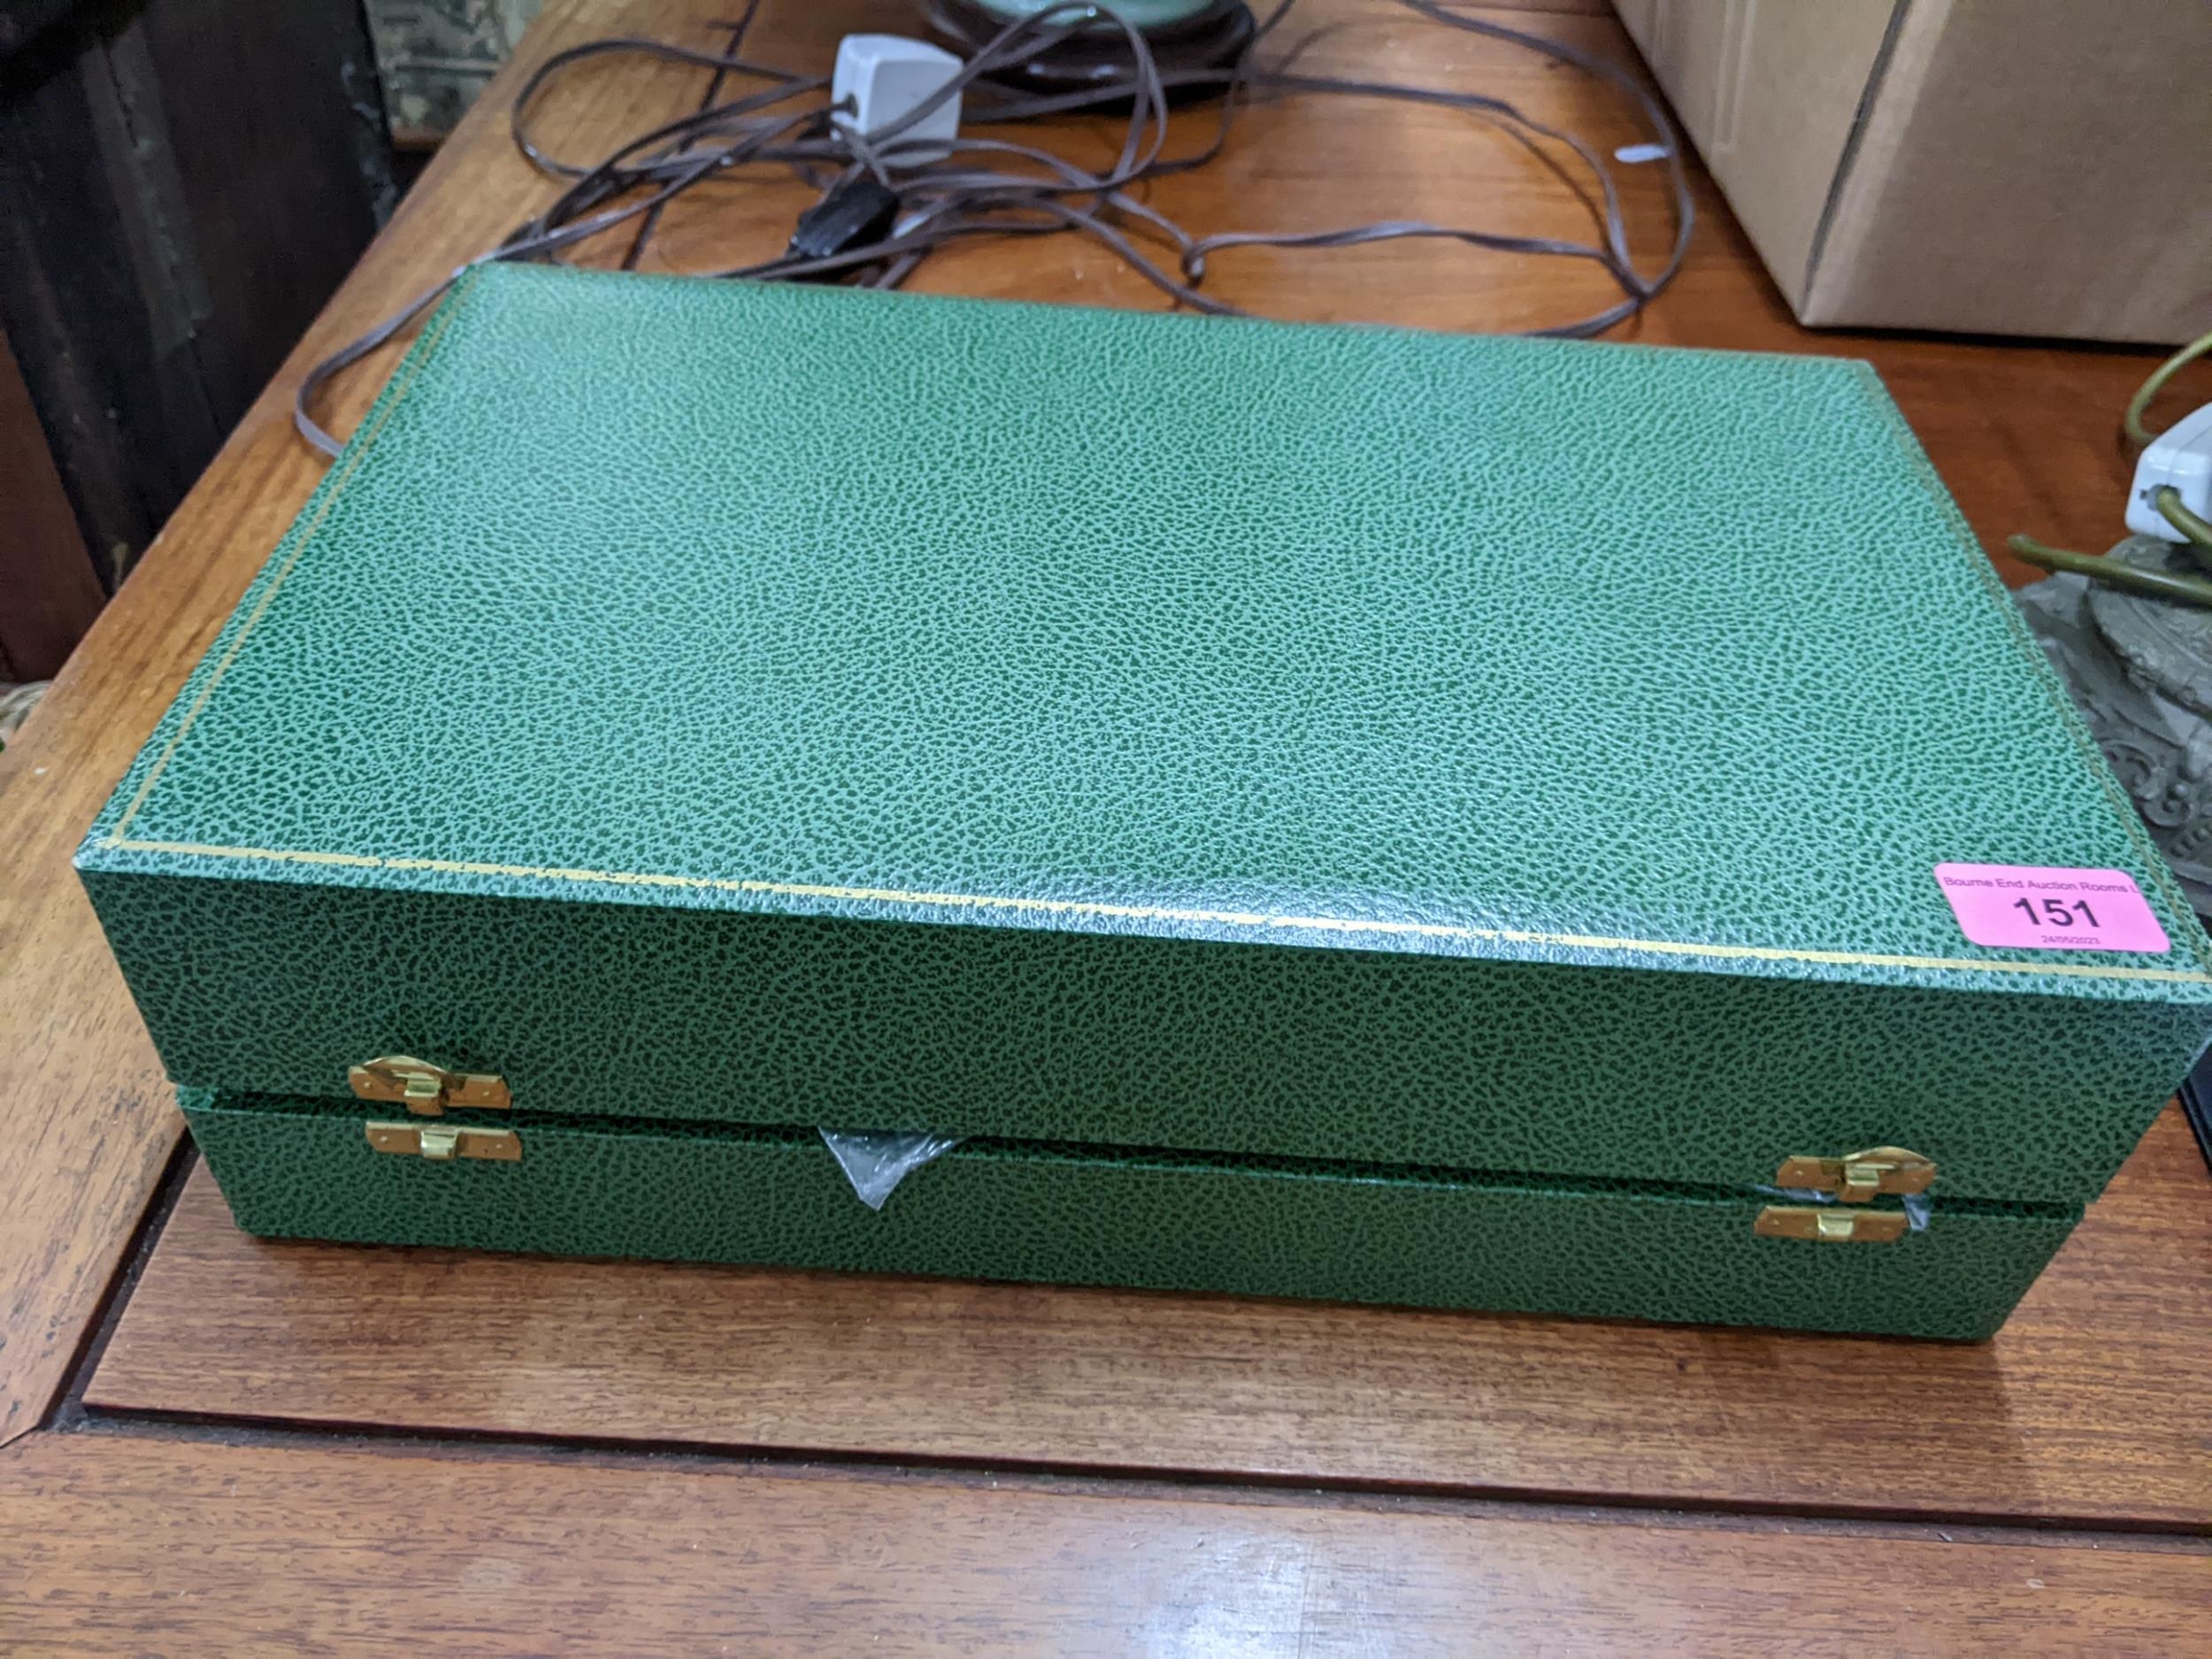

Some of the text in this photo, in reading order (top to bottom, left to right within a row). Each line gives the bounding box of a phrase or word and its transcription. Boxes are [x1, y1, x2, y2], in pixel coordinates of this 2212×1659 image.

[1943, 877, 1993, 887] Bourne
[1995, 878, 2024, 888] End
[2027, 880, 2077, 891] Auction
[2080, 881, 2128, 893] Rooms
[2013, 897, 2101, 928] 151
